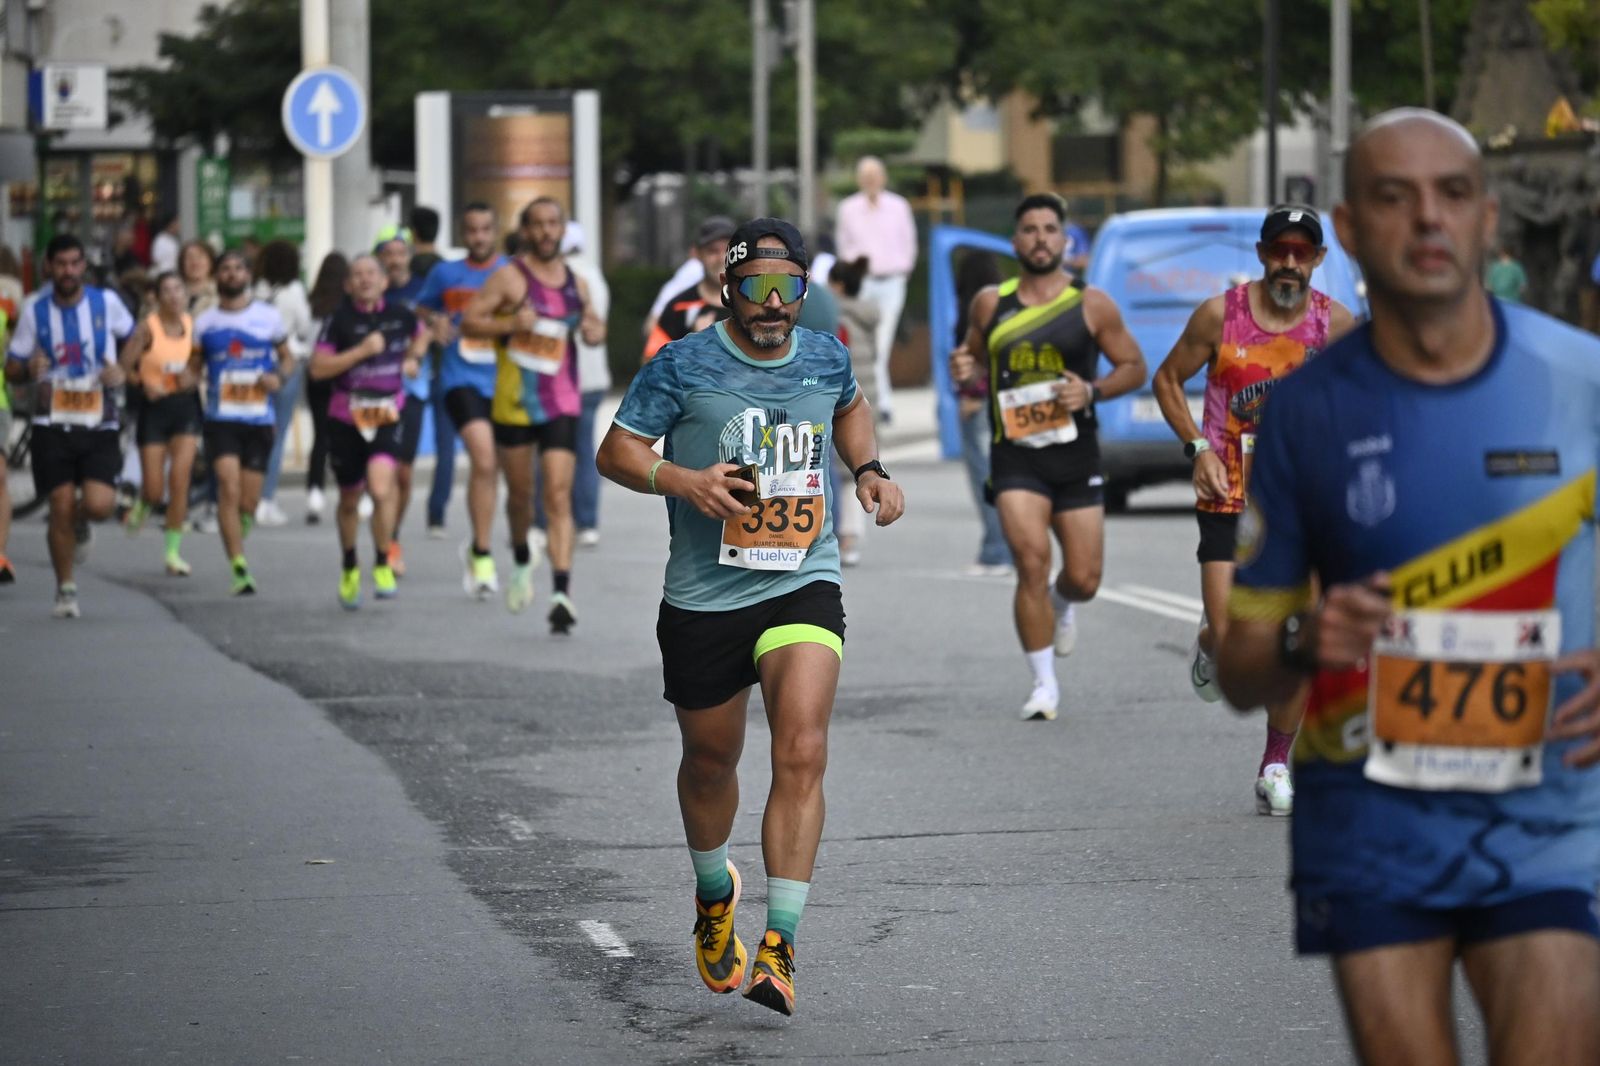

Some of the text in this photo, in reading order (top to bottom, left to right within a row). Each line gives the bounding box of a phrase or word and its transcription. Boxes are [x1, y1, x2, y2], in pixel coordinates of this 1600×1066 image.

[1015, 399, 1062, 429] 562
[741, 498, 814, 534] 335
[749, 548, 798, 562] Huelva
[1404, 540, 1505, 606] CLUB
[1399, 660, 1528, 723] 476
